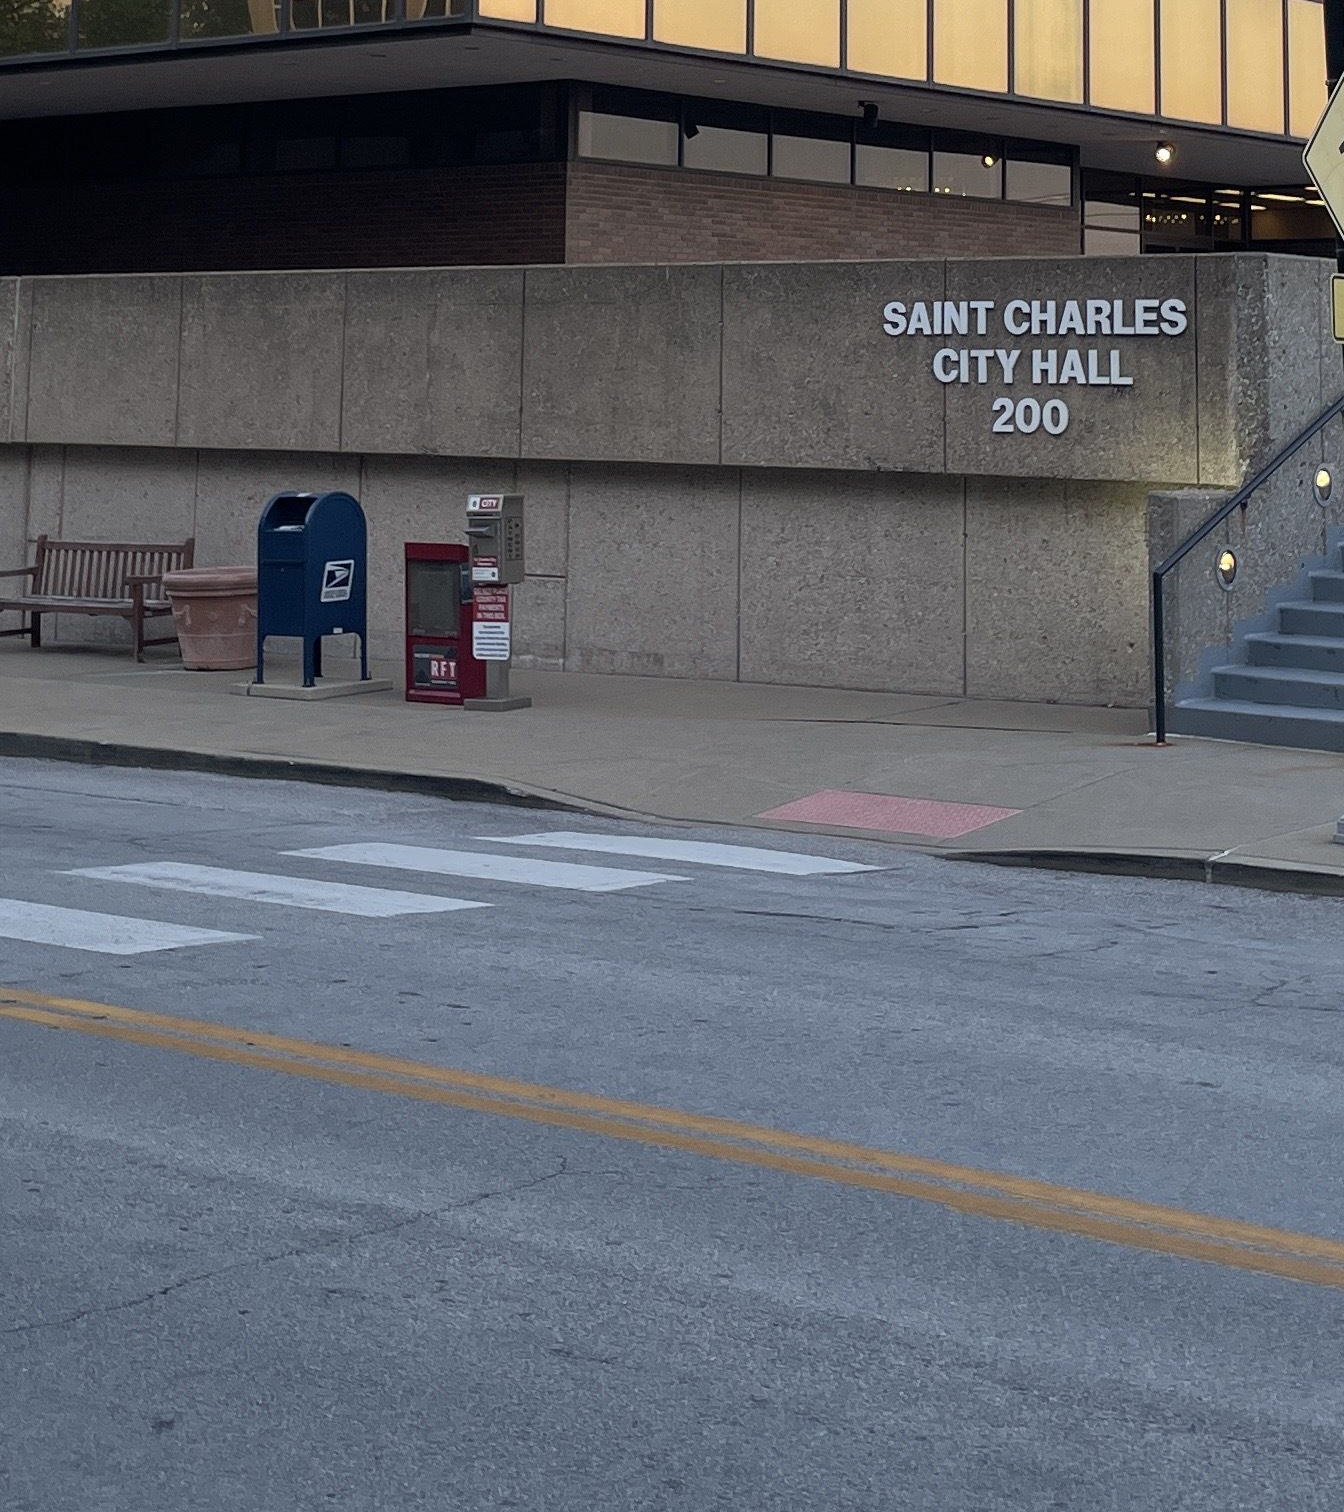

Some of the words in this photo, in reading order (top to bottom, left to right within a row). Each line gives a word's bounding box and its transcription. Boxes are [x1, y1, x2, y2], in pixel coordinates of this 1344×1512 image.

[883, 300, 994, 336] SAINT
[1003, 298, 1188, 336] CHARLES
[933, 348, 1020, 384] CITY
[1032, 349, 1134, 385] HALL
[992, 397, 1069, 435] 200
[481, 499, 497, 508] CITY
[431, 660, 457, 678] RFT
